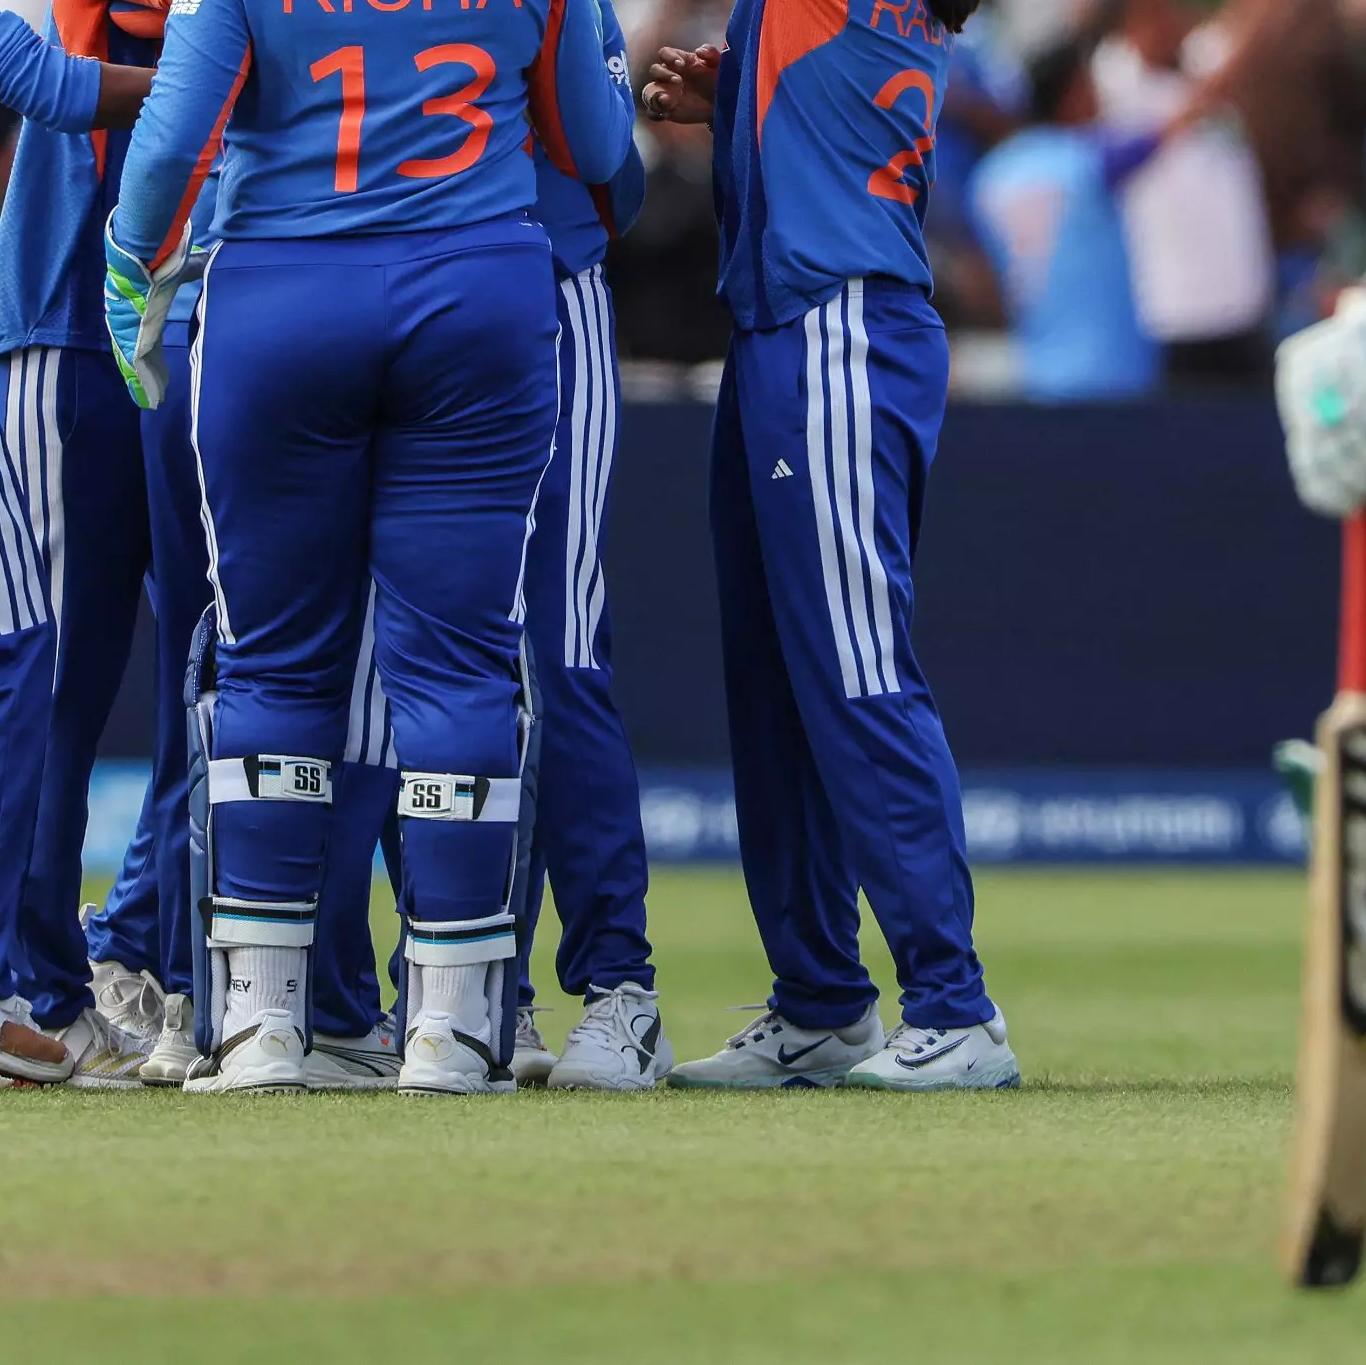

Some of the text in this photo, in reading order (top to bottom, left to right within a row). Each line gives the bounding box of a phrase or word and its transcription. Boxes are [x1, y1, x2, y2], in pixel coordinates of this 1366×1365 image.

[309, 42, 497, 193] 13
[294, 765, 321, 792] SS
[412, 784, 441, 808] SS
